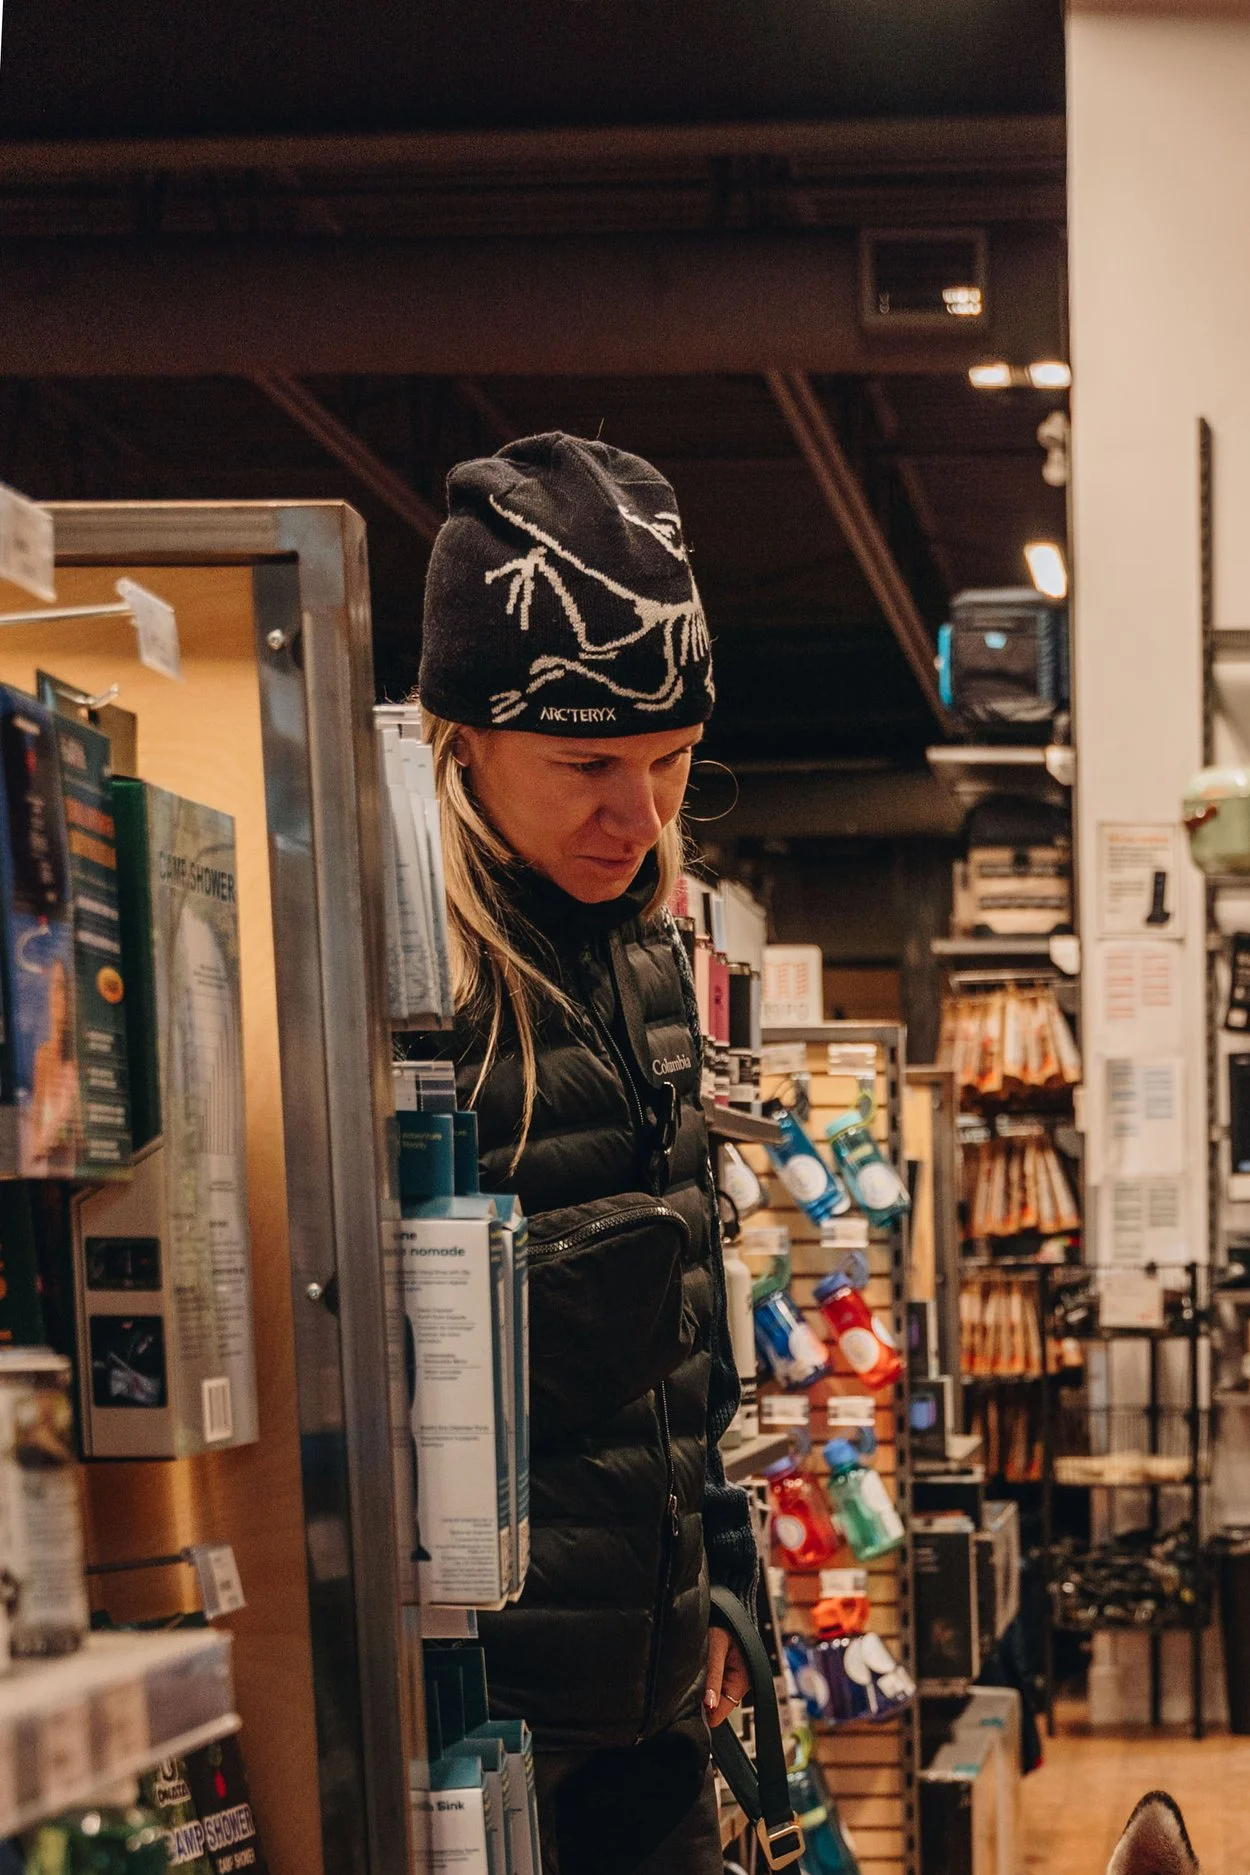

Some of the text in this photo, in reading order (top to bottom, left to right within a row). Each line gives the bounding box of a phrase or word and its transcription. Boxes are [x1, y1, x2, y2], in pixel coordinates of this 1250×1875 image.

[540, 706, 616, 722] ARC'TERYX
[652, 1054, 692, 1075] Columbia
[410, 1246, 467, 1258] nomade
[437, 1800, 465, 1811] Sink
[204, 1803, 257, 1851] SHOWER
